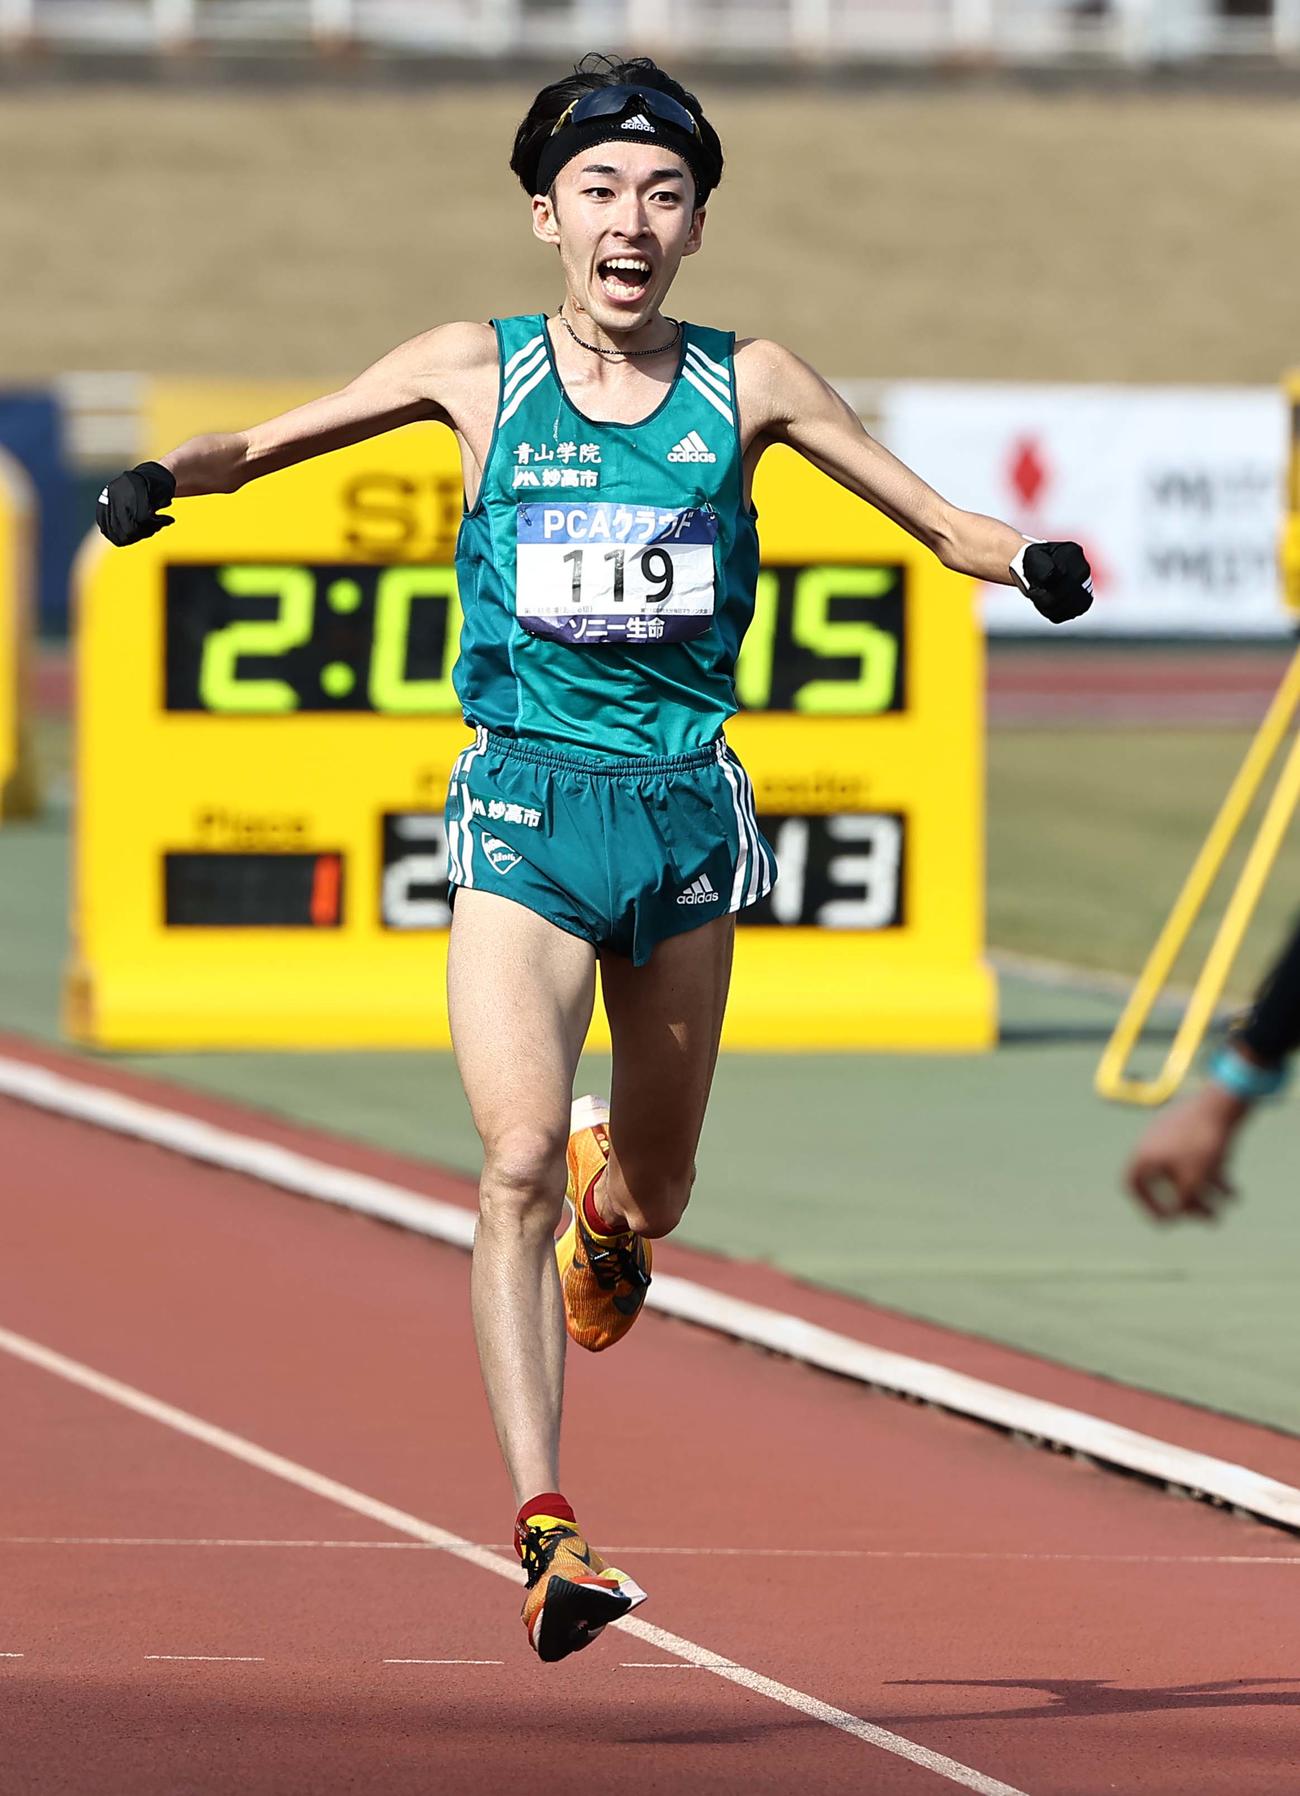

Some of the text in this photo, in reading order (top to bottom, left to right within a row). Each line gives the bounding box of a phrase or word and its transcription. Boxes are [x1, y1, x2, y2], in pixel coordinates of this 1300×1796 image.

[620, 122, 656, 133] adidas
[512, 441, 602, 465] 青山学院
[667, 451, 717, 463] adidas
[542, 468, 599, 488] 妙高市
[543, 508, 694, 540] PCAクラウド
[563, 547, 674, 603] 119
[569, 616, 666, 640] ソニー生命
[487, 799, 542, 828] 妙高市
[676, 892, 719, 904] adidas
